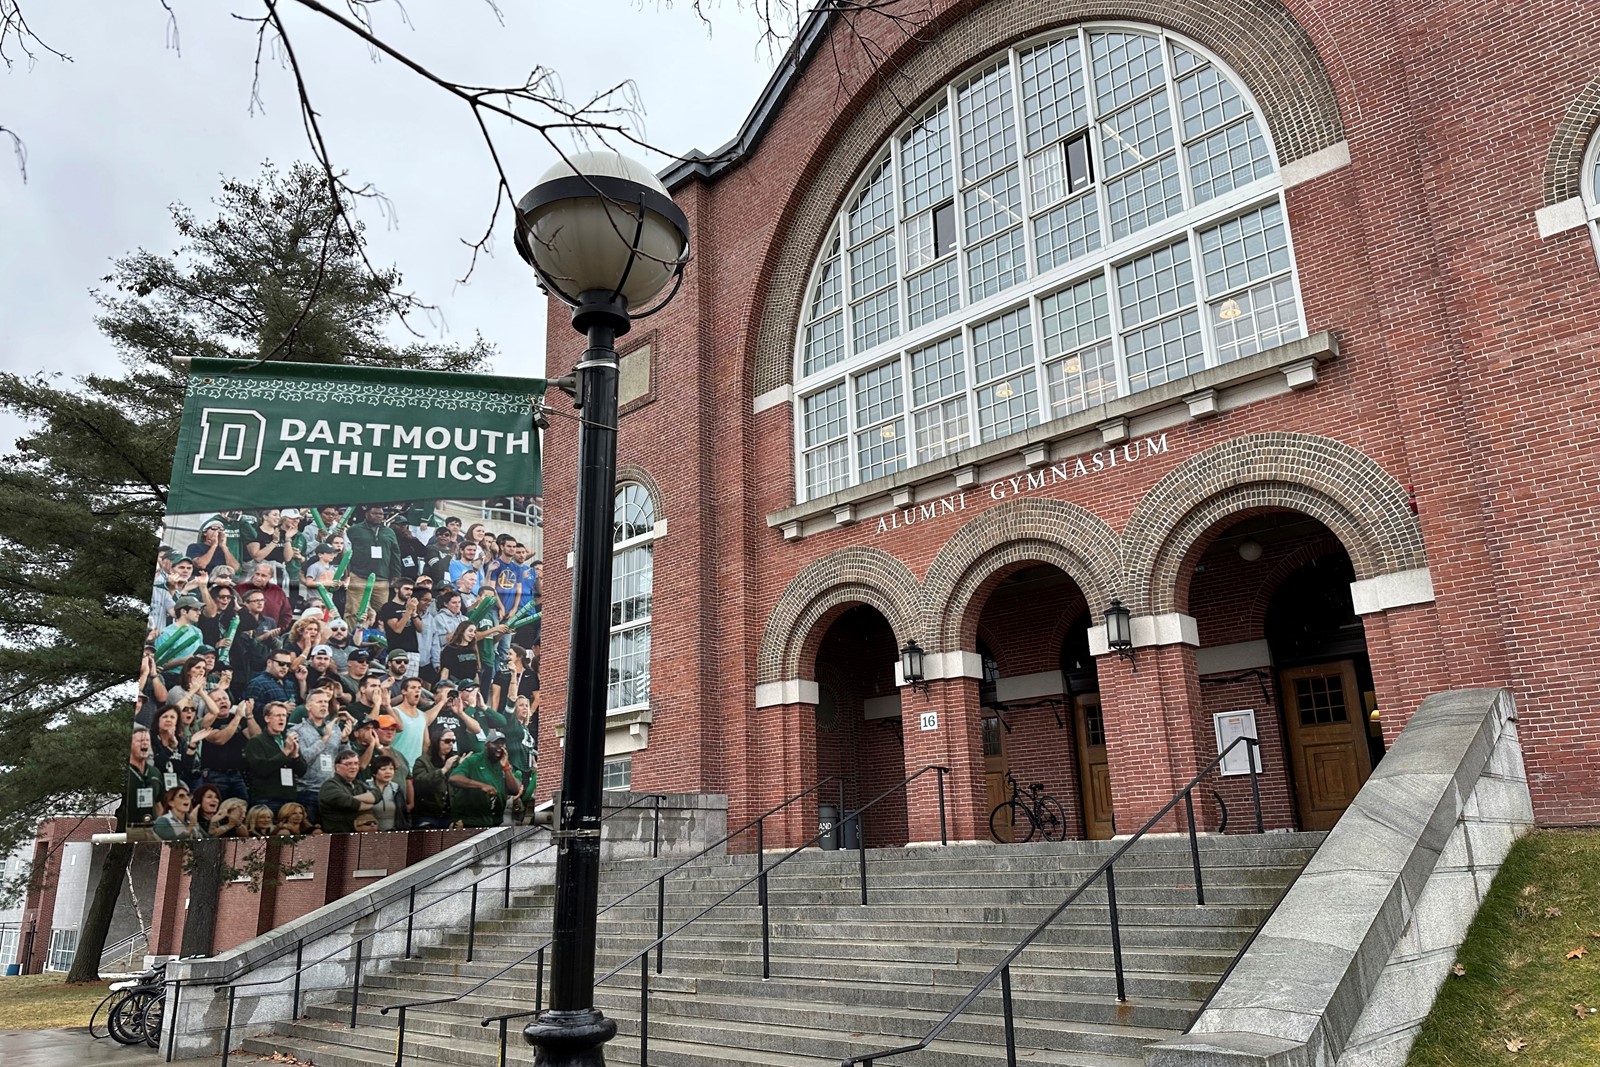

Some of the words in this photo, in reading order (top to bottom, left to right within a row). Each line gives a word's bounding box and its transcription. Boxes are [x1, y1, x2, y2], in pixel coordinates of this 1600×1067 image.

[192, 407, 266, 476] D
[279, 418, 530, 455] DARTMOUTH
[274, 447, 498, 484] ATHLETICS
[875, 493, 966, 535] ALUMNI
[990, 432, 1170, 501] GYMNASIUM
[923, 714, 936, 728] 16
